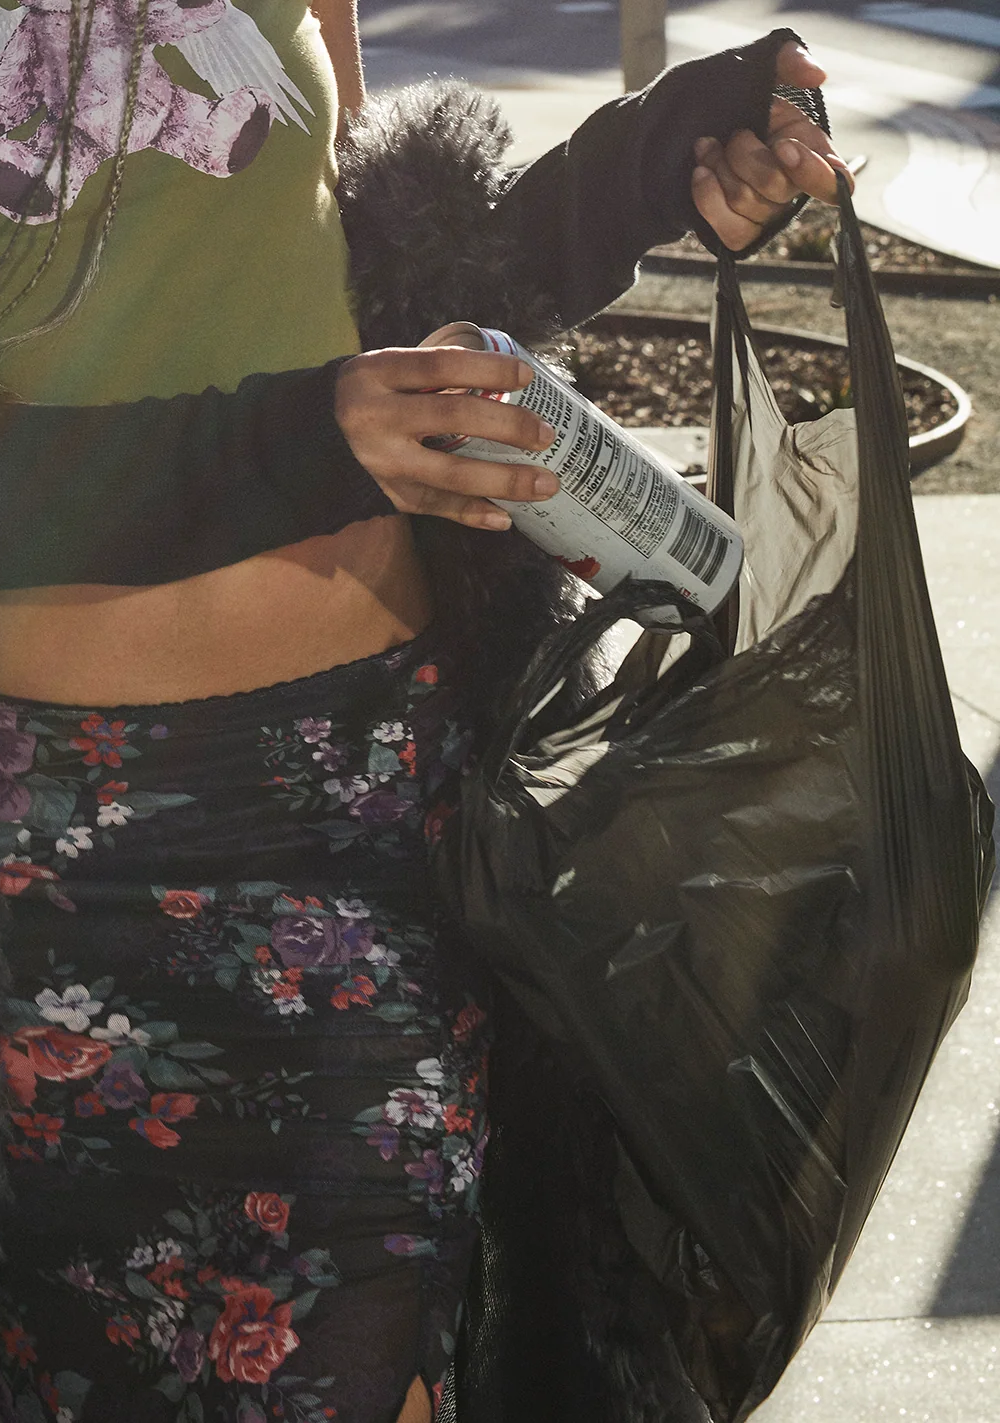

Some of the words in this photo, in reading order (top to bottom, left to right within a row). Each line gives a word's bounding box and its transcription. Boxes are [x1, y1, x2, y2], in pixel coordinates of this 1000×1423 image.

[541, 389, 546, 398] OF
[542, 400, 551, 414] AND
[549, 405, 556, 416] NO
[553, 410, 562, 426] HARD
[540, 430, 566, 465] MADE
[577, 464, 607, 503] Calories
[603, 427, 613, 448] 170
